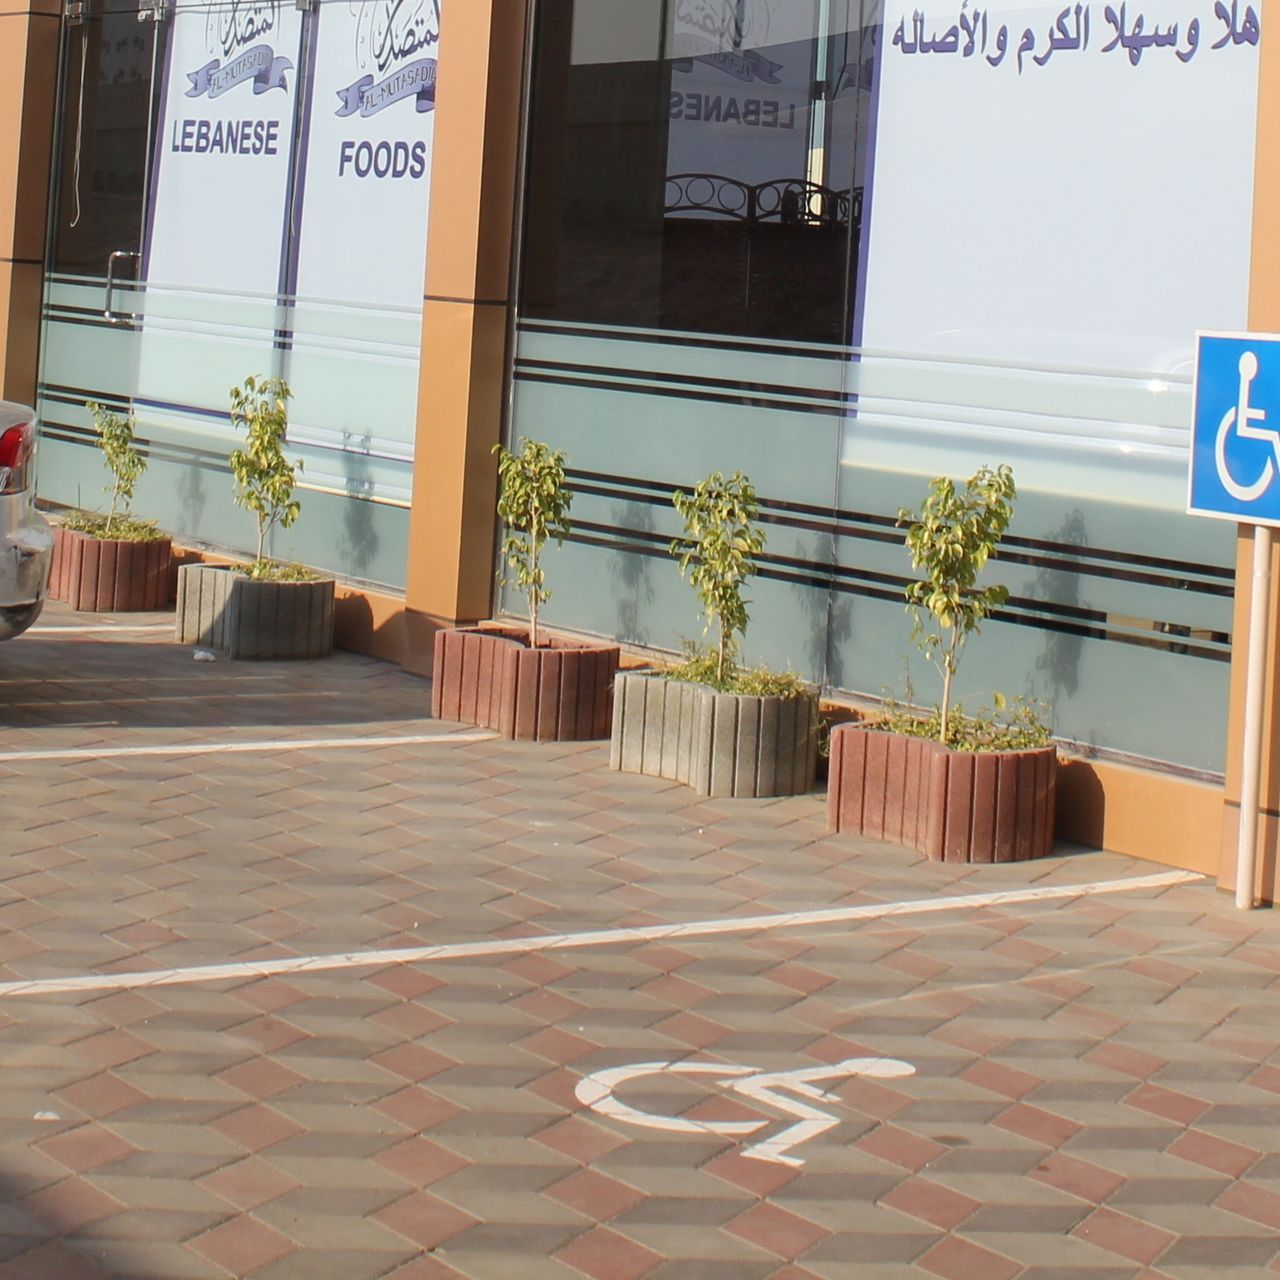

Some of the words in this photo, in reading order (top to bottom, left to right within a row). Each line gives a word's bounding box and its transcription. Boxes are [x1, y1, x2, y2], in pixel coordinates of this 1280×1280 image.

[1016, 1, 1090, 75] الكرم
[171, 119, 279, 156] LEBANESE
[339, 140, 427, 179] FOODS
